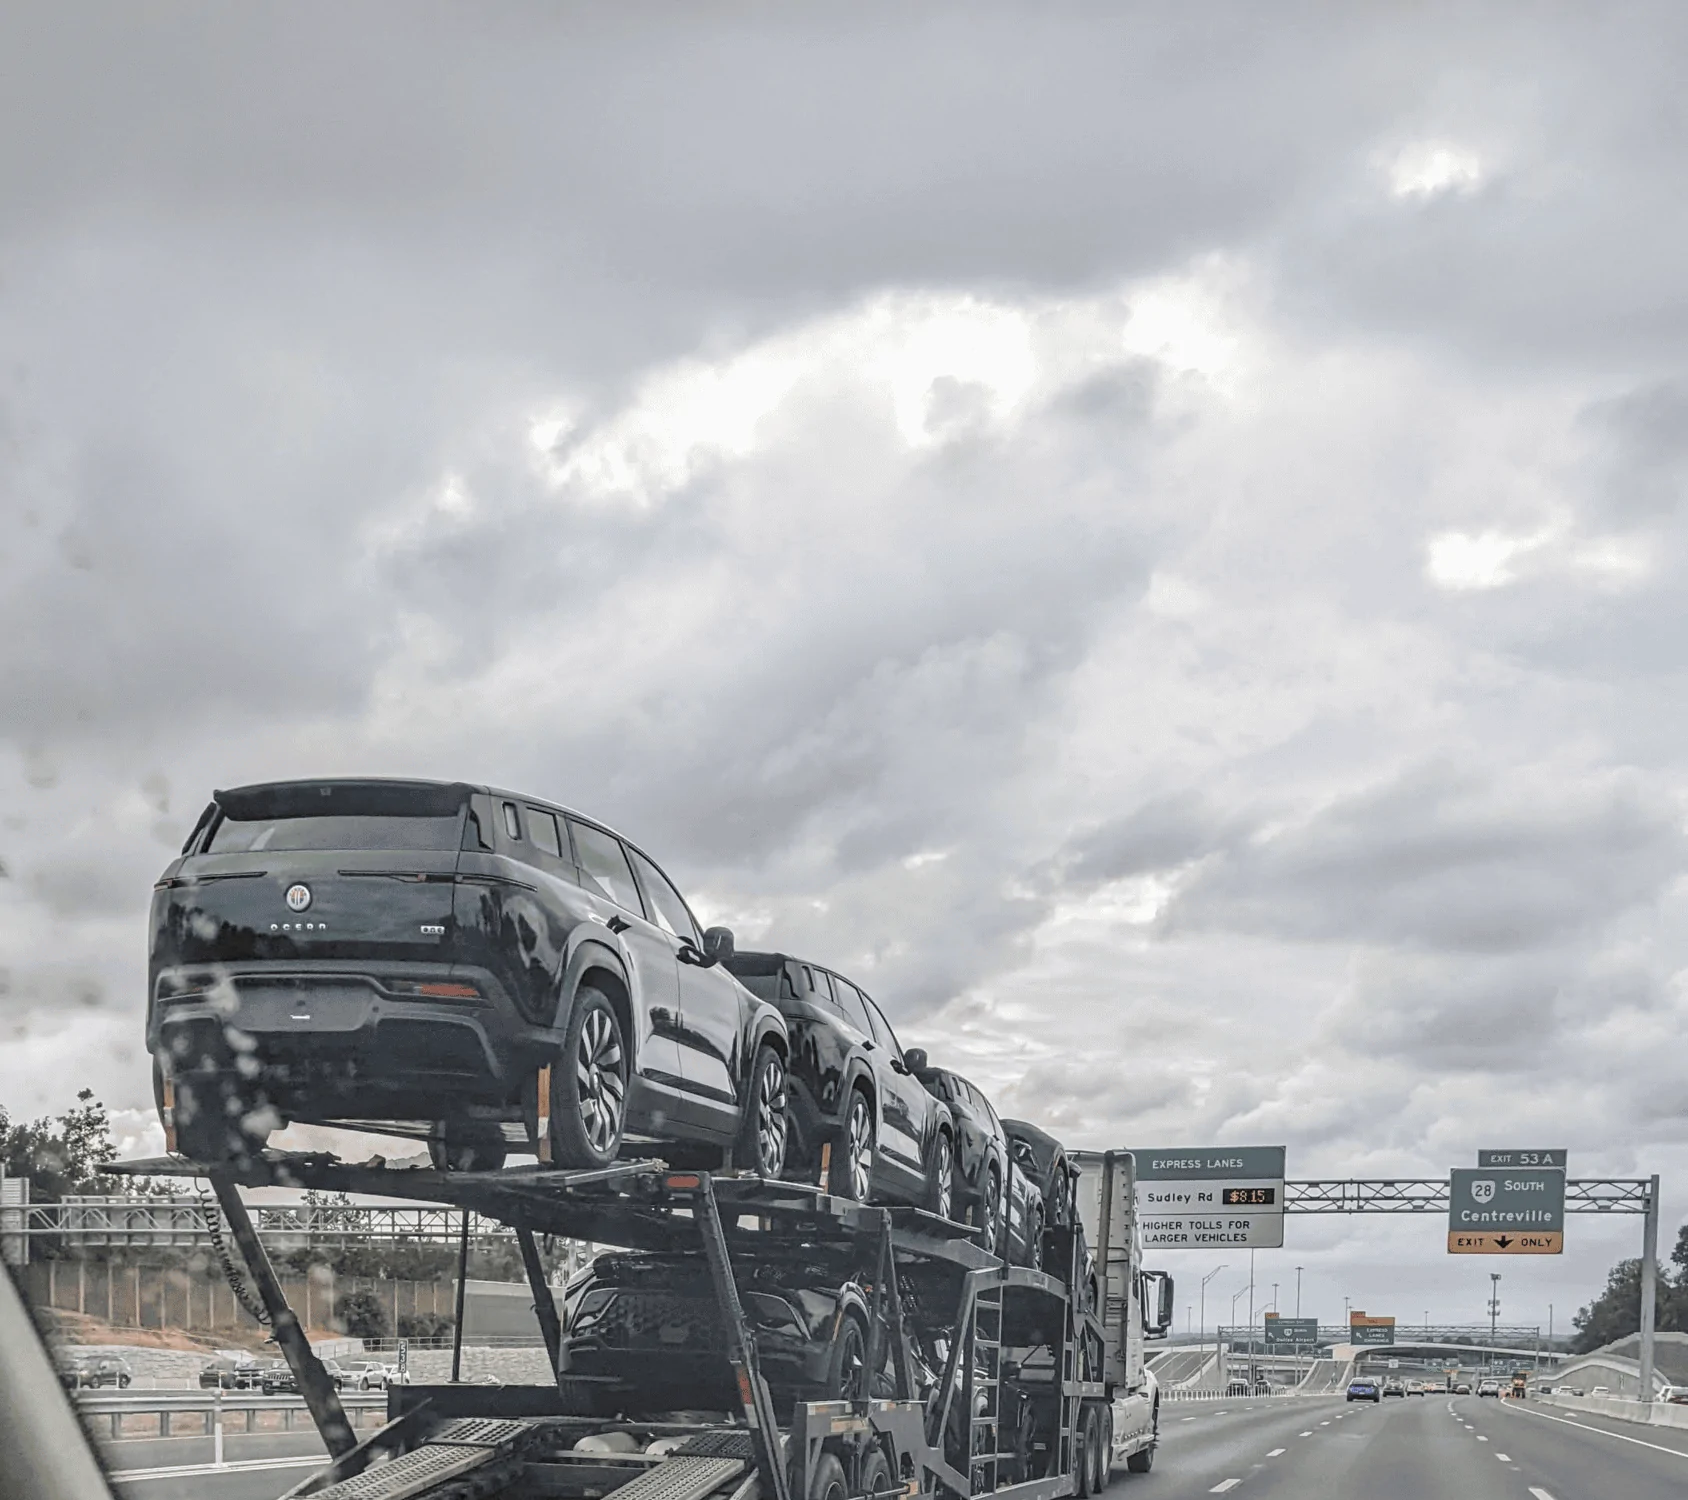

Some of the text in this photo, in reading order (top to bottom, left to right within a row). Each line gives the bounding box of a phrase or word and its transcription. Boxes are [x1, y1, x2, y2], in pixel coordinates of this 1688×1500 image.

[1152, 1158, 1244, 1169] EXPRESS LANES
[1490, 1154, 1512, 1163] EXIT
[1474, 1184, 1492, 1197] 28
[1503, 1180, 1545, 1191] SOUTH
[1147, 1189, 1266, 1204] Sudley Rd $8.15
[1460, 1209, 1553, 1222] Centreville
[1142, 1220, 1250, 1230] HIGHER TOLLS FOR
[1144, 1232, 1248, 1242] LARGER VEHICLES
[1457, 1237, 1552, 1247] EXIT ONLY
